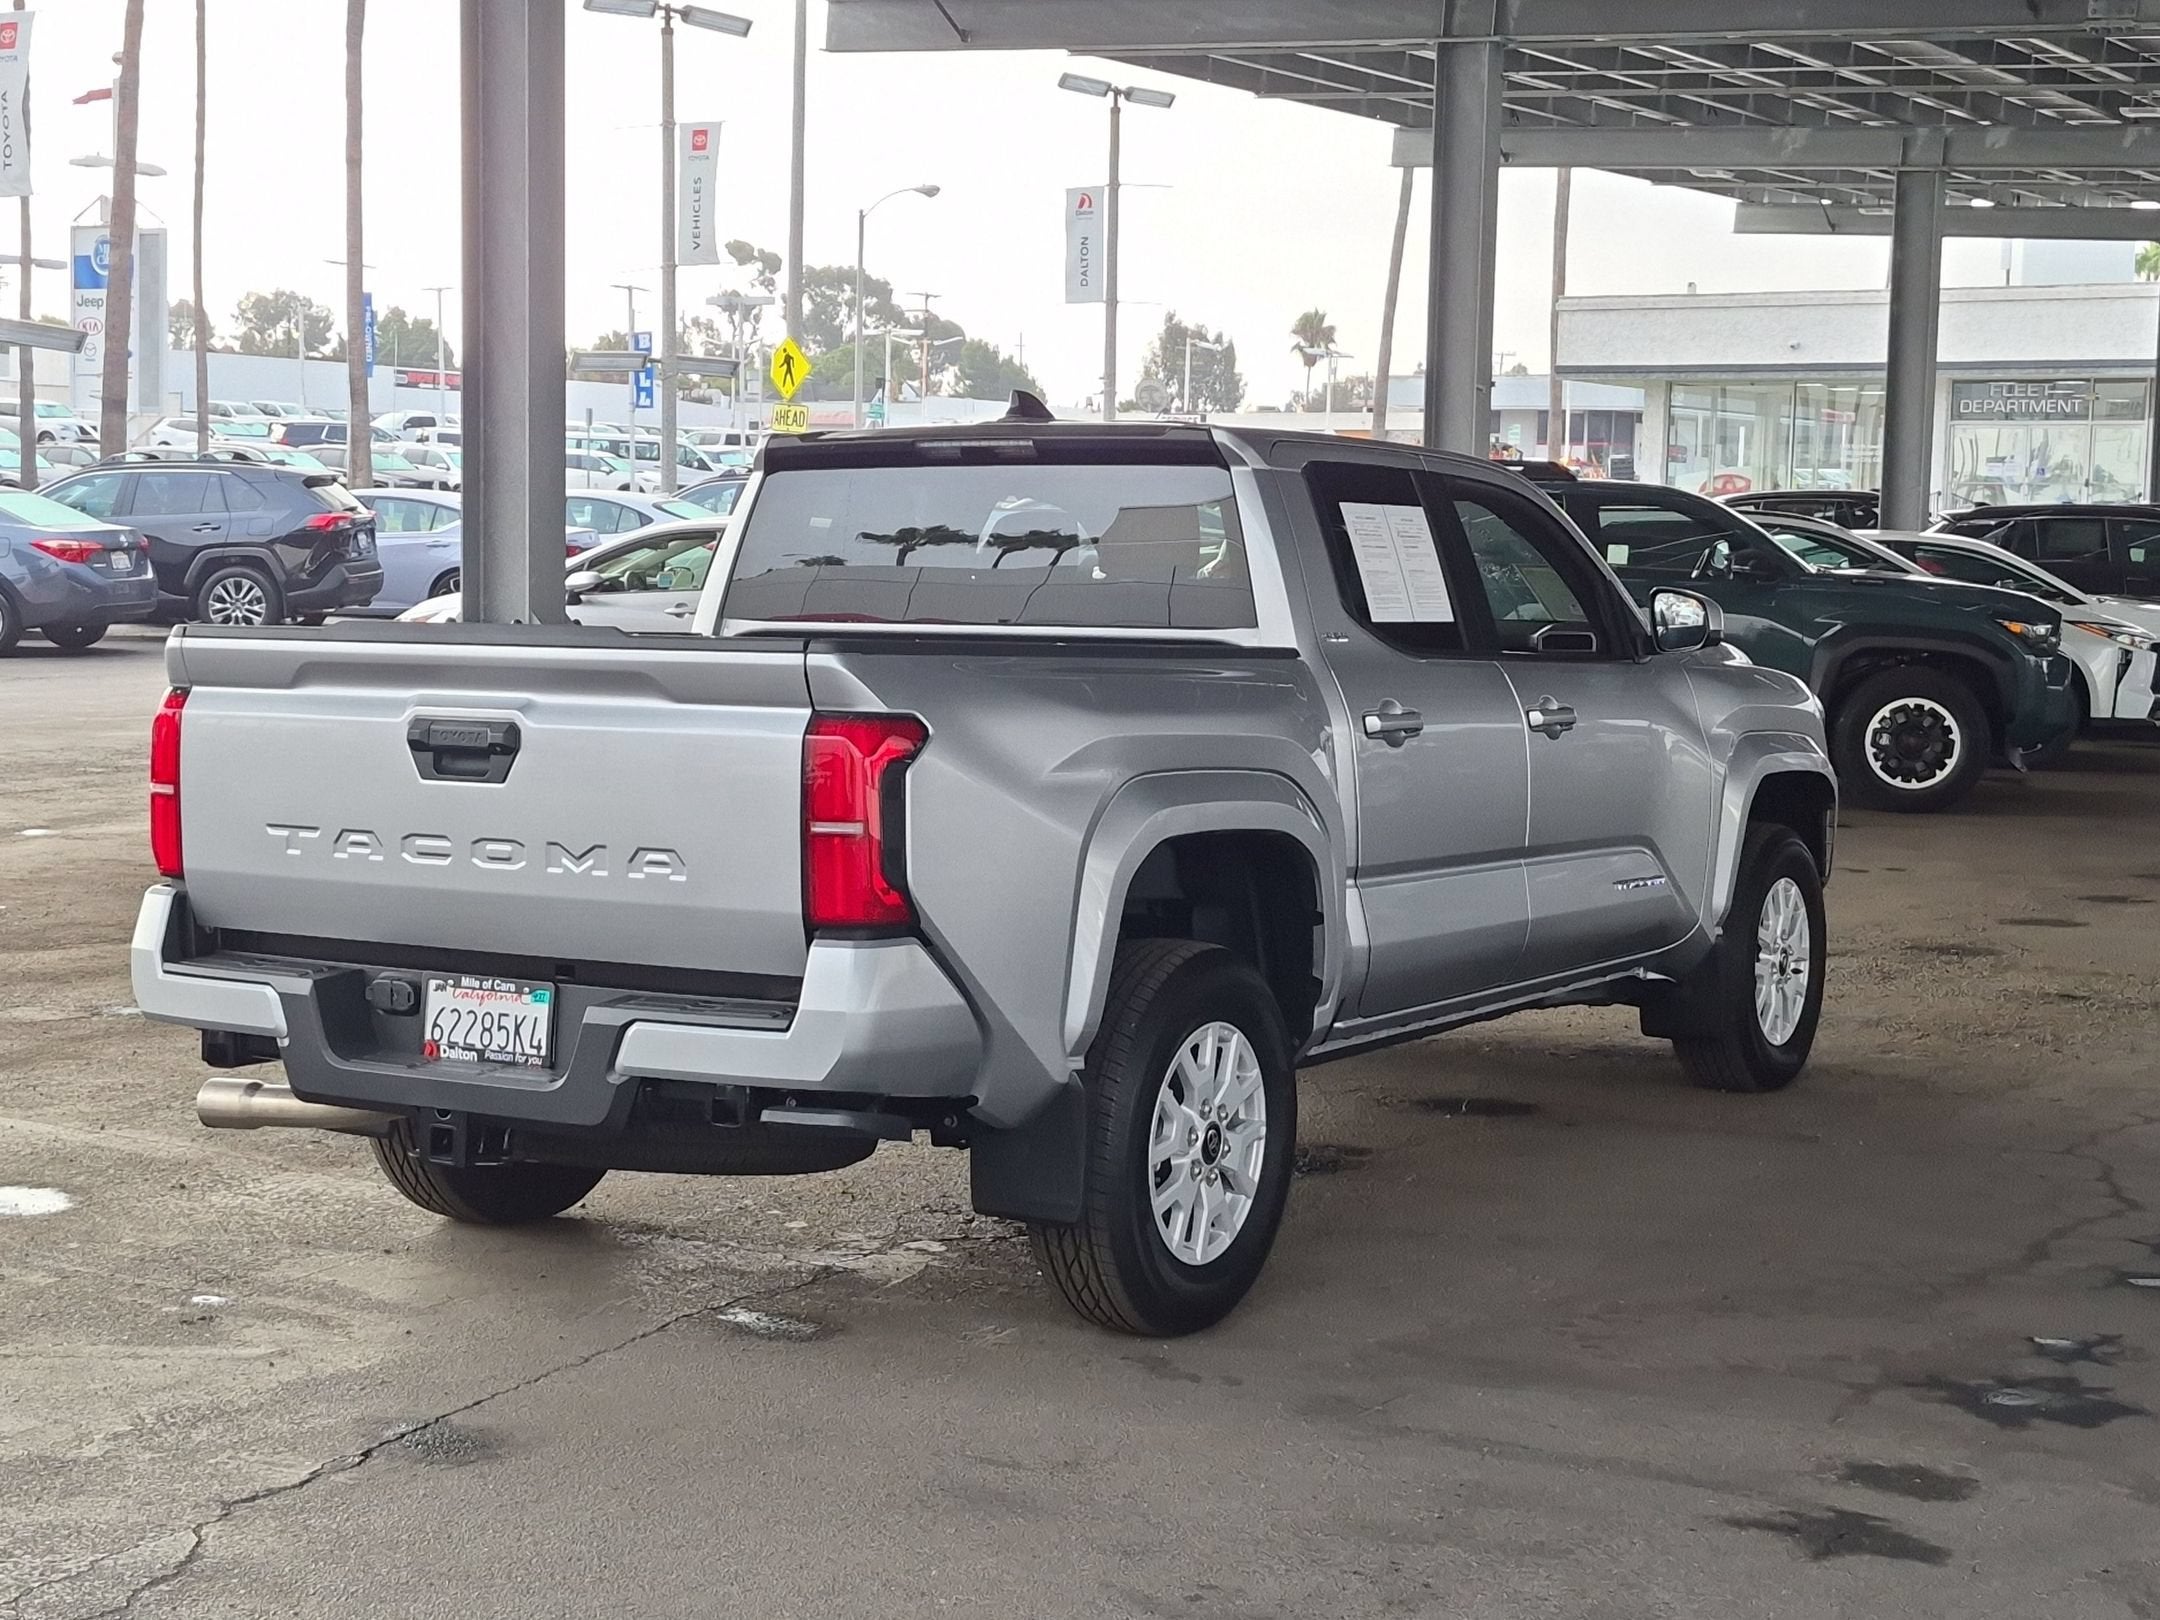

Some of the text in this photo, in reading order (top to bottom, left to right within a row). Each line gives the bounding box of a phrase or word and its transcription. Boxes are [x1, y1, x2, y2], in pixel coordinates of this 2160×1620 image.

[1, 90, 13, 170] TOYOTA
[692, 177, 702, 250] VEHICLES
[1080, 236, 1089, 287] DALTON
[76, 294, 104, 310] Jeep
[639, 334, 651, 406] BLL
[1989, 383, 2055, 397] FLEET
[1959, 400, 2083, 413] DEPARTMENT
[774, 410, 806, 427] AHEAD
[266, 823, 687, 882] TACOMA
[461, 976, 516, 992] Mile of Cars
[452, 987, 530, 1006] California
[431, 1006, 543, 1055] 62285K4
[441, 1045, 542, 1065] Dalton Passion for you
